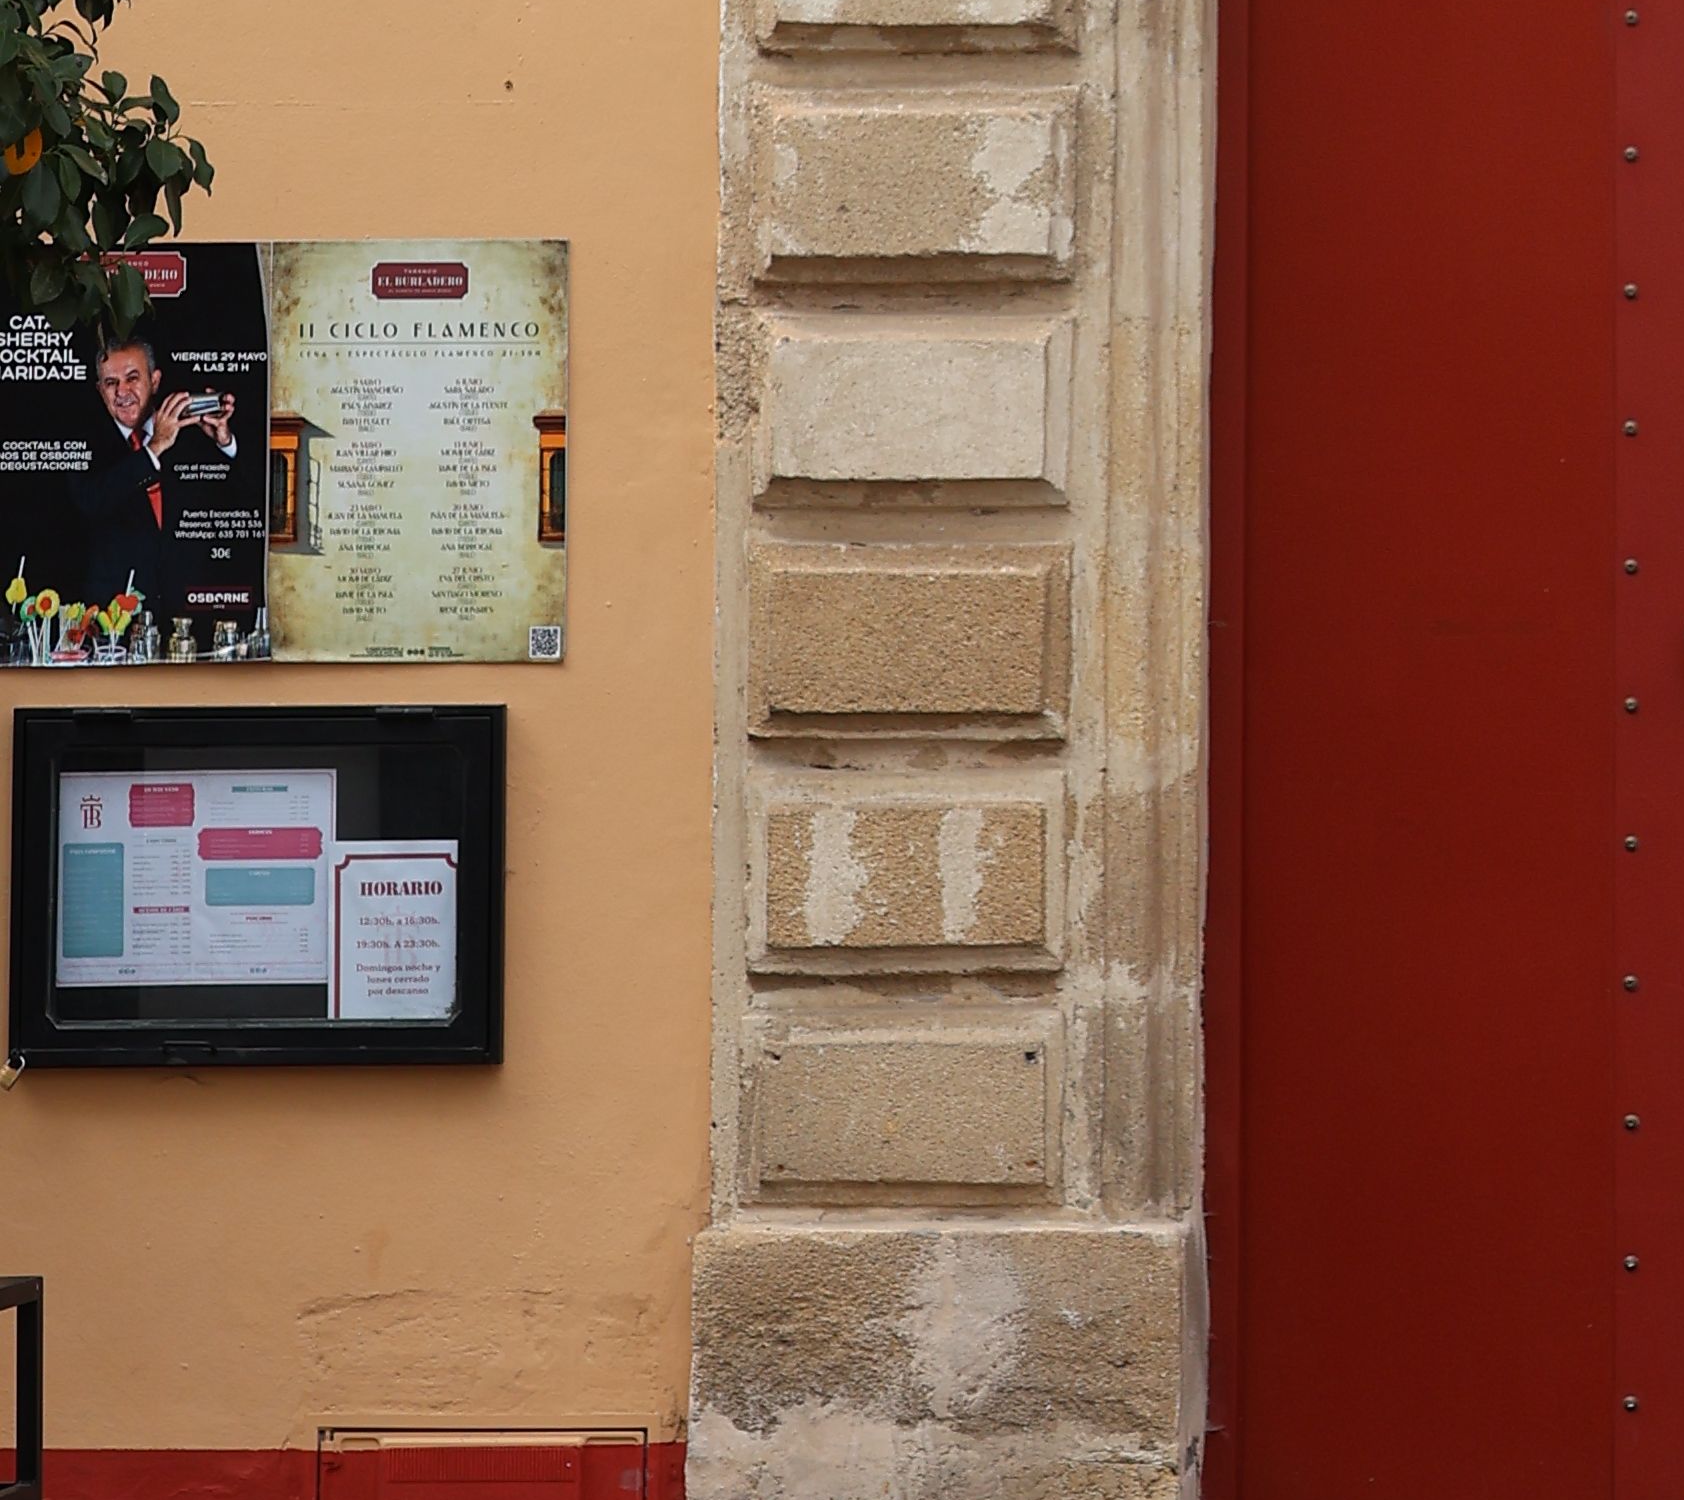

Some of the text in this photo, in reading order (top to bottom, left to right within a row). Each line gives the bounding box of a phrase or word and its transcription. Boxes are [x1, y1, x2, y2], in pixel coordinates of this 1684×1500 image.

[378, 276, 463, 286] EL BURLADERO
[329, 322, 398, 338] CICLO
[413, 322, 540, 338] FLAMENCO
[0, 349, 80, 364] OCKTAIL
[171, 352, 267, 361] VIERNES 29 MAYO
[0, 365, 87, 380] ARIDAJE
[192, 363, 249, 372] A LAS 21 H
[2, 441, 87, 450] COCKTAILS CON
[22, 451, 37, 460] DE
[40, 451, 92, 460] OSBORNE
[0, 461, 89, 471] DEGUSTACIONES
[179, 472, 198, 480] Juan
[183, 510, 208, 519] Puerto
[214, 520, 230, 529] 956
[231, 520, 246, 529] 543
[247, 520, 262, 529] 536
[235, 530, 249, 539] 701
[211, 548, 231, 559] 30€
[187, 592, 249, 604] OSBORNE
[360, 880, 443, 896] HORARIO
[356, 964, 403, 974] Domingos
[405, 963, 434, 972] noche
[367, 975, 430, 984] lunes cerrado
[367, 986, 429, 998] por descanso
